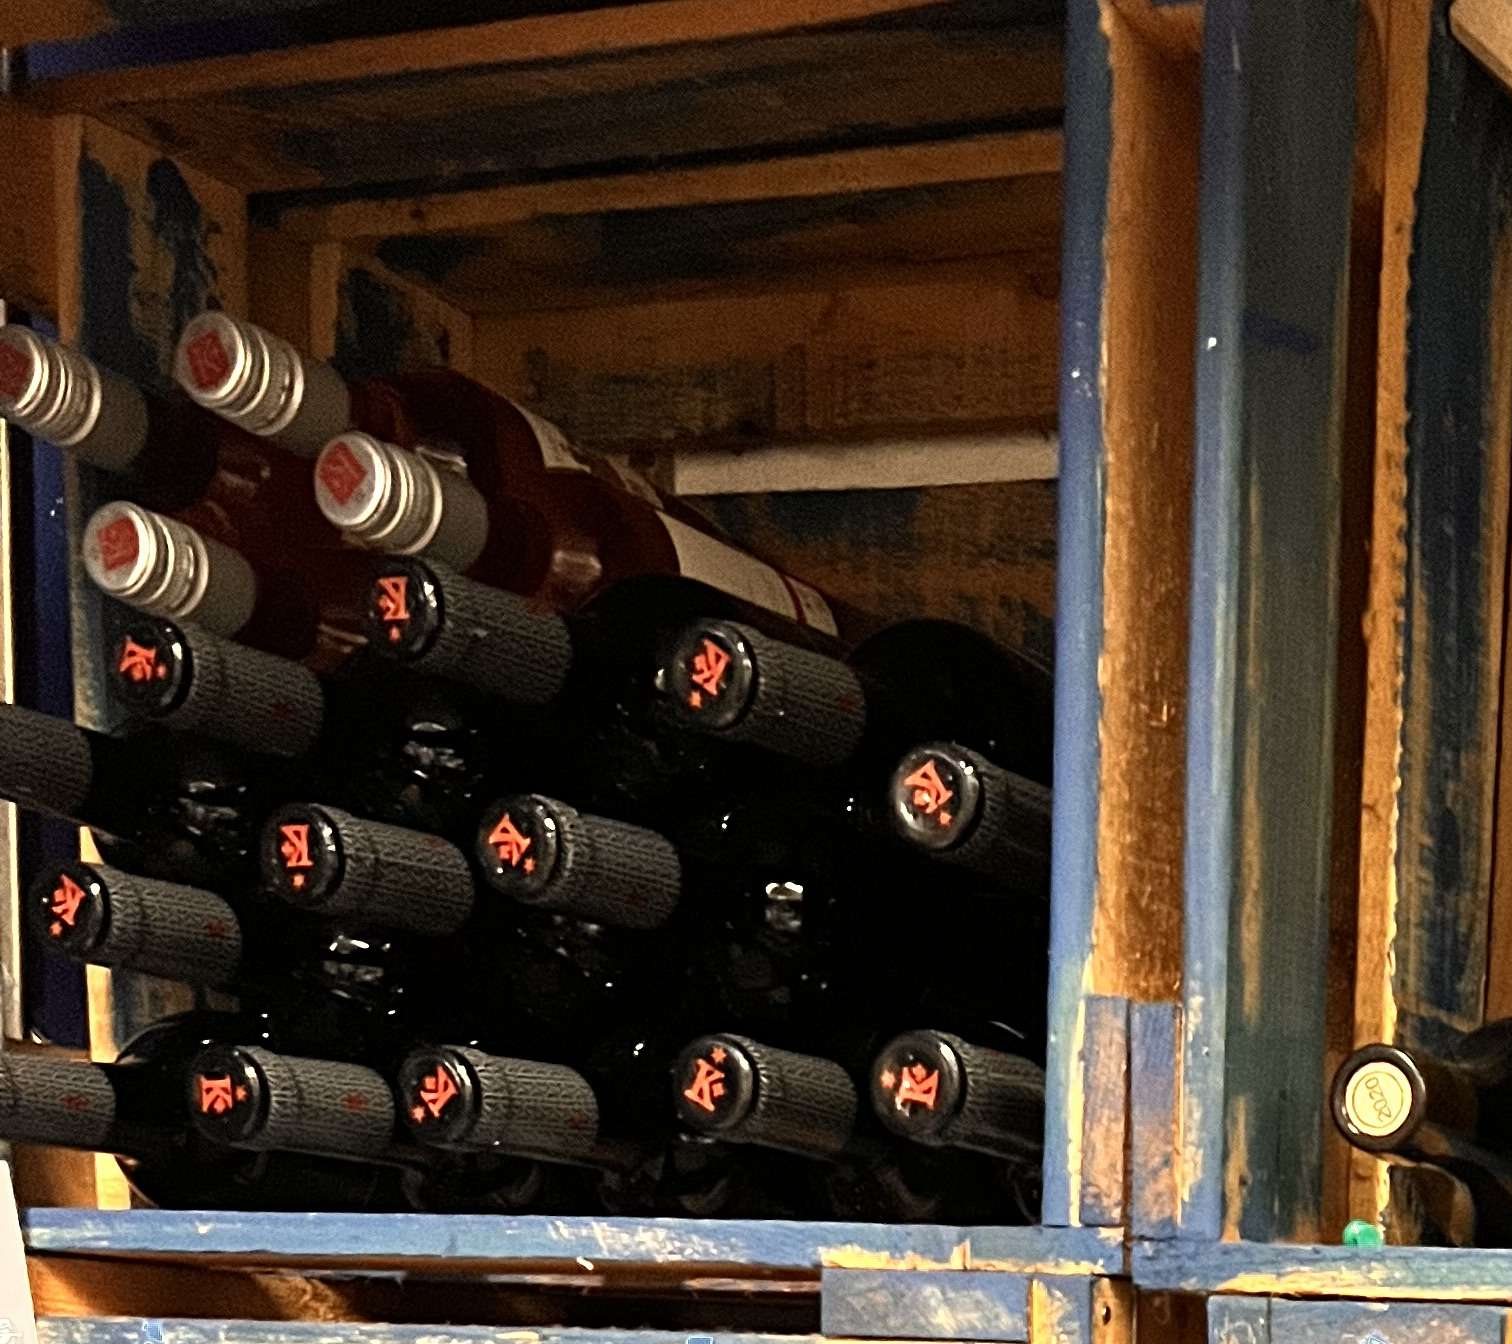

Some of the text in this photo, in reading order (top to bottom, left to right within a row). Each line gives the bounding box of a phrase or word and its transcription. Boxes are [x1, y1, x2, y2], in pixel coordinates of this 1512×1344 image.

[378, 576, 410, 620] K
[120, 634, 156, 680] K
[691, 639, 731, 695] K
[904, 760, 953, 813] K
[279, 824, 314, 867] K
[488, 811, 531, 866] K
[51, 874, 86, 925] K
[200, 1073, 233, 1114] K
[419, 1062, 459, 1117] K
[684, 1058, 725, 1112] K
[900, 1063, 938, 1110] K
[1365, 1077, 1392, 1121] 2020
